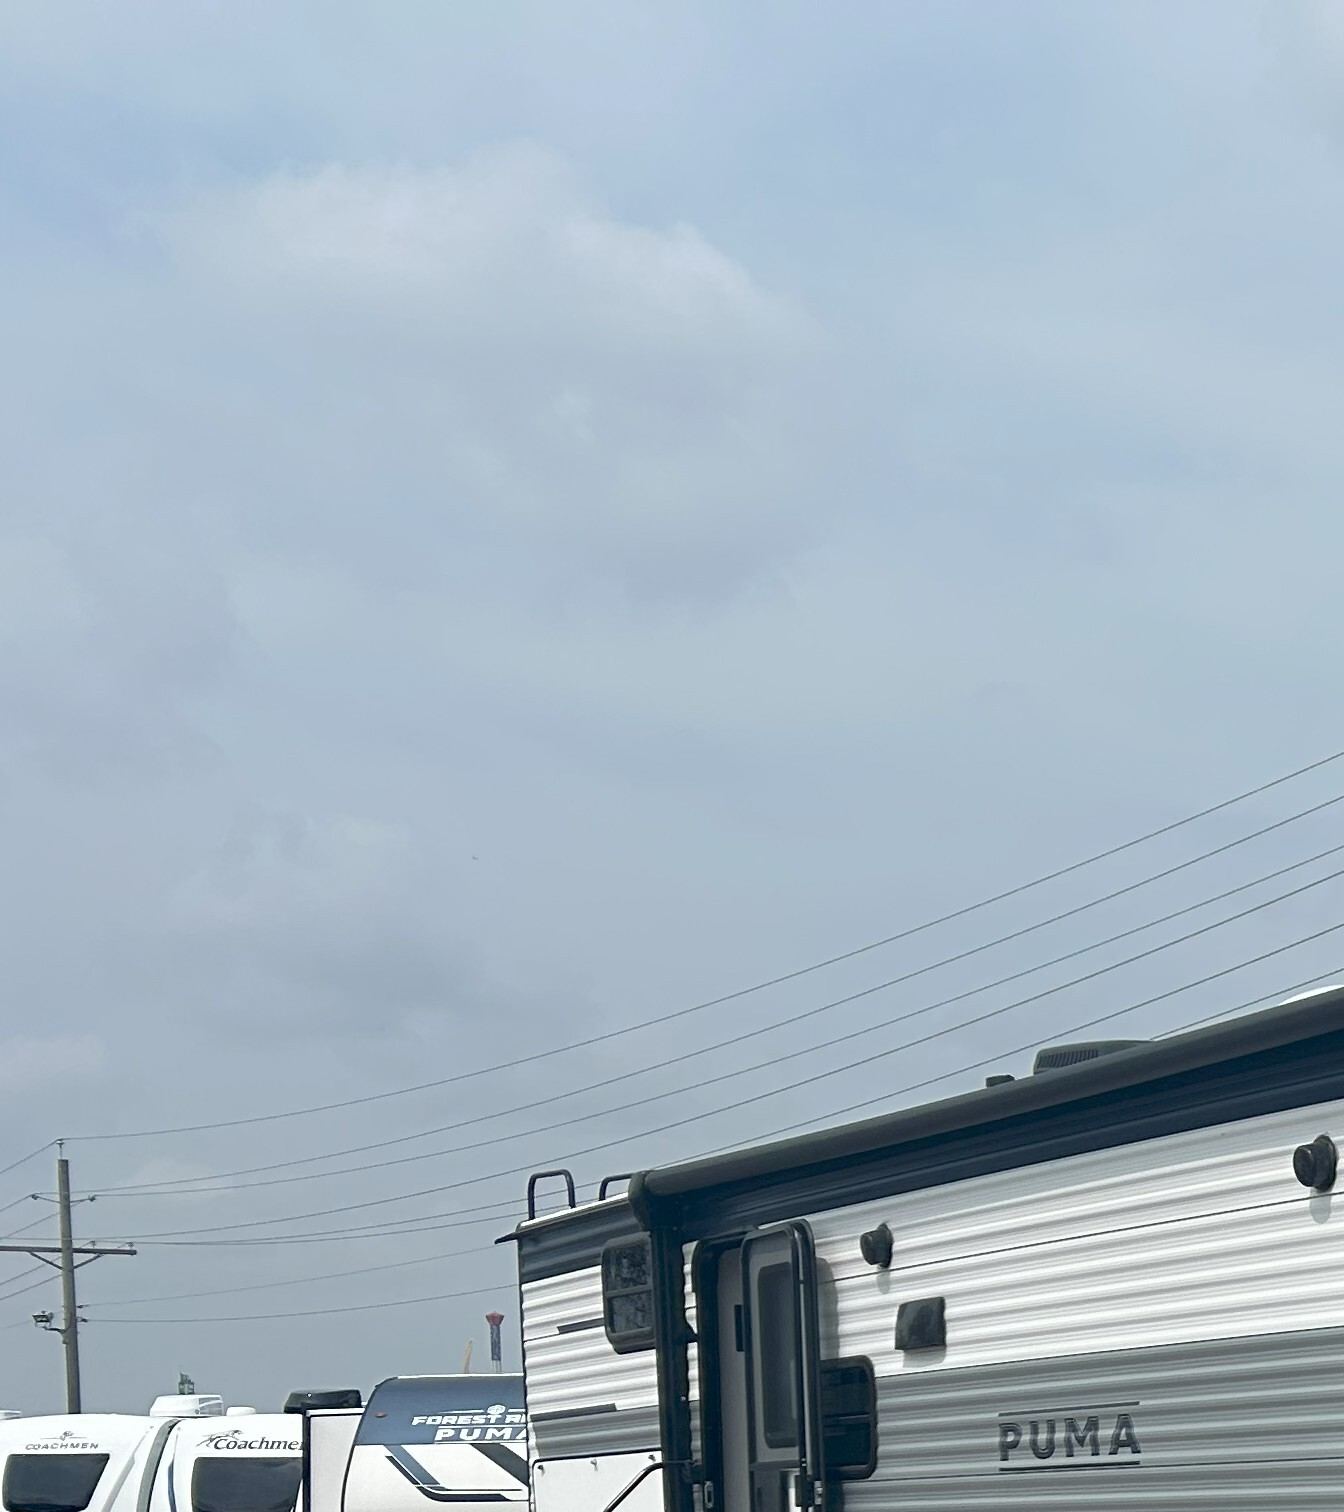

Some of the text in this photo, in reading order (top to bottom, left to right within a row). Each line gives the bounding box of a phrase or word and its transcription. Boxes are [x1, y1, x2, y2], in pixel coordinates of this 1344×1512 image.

[411, 1414, 502, 1426] FOREST
[999, 1413, 1142, 1462] PUMA
[25, 1442, 99, 1451] COACHMEN
